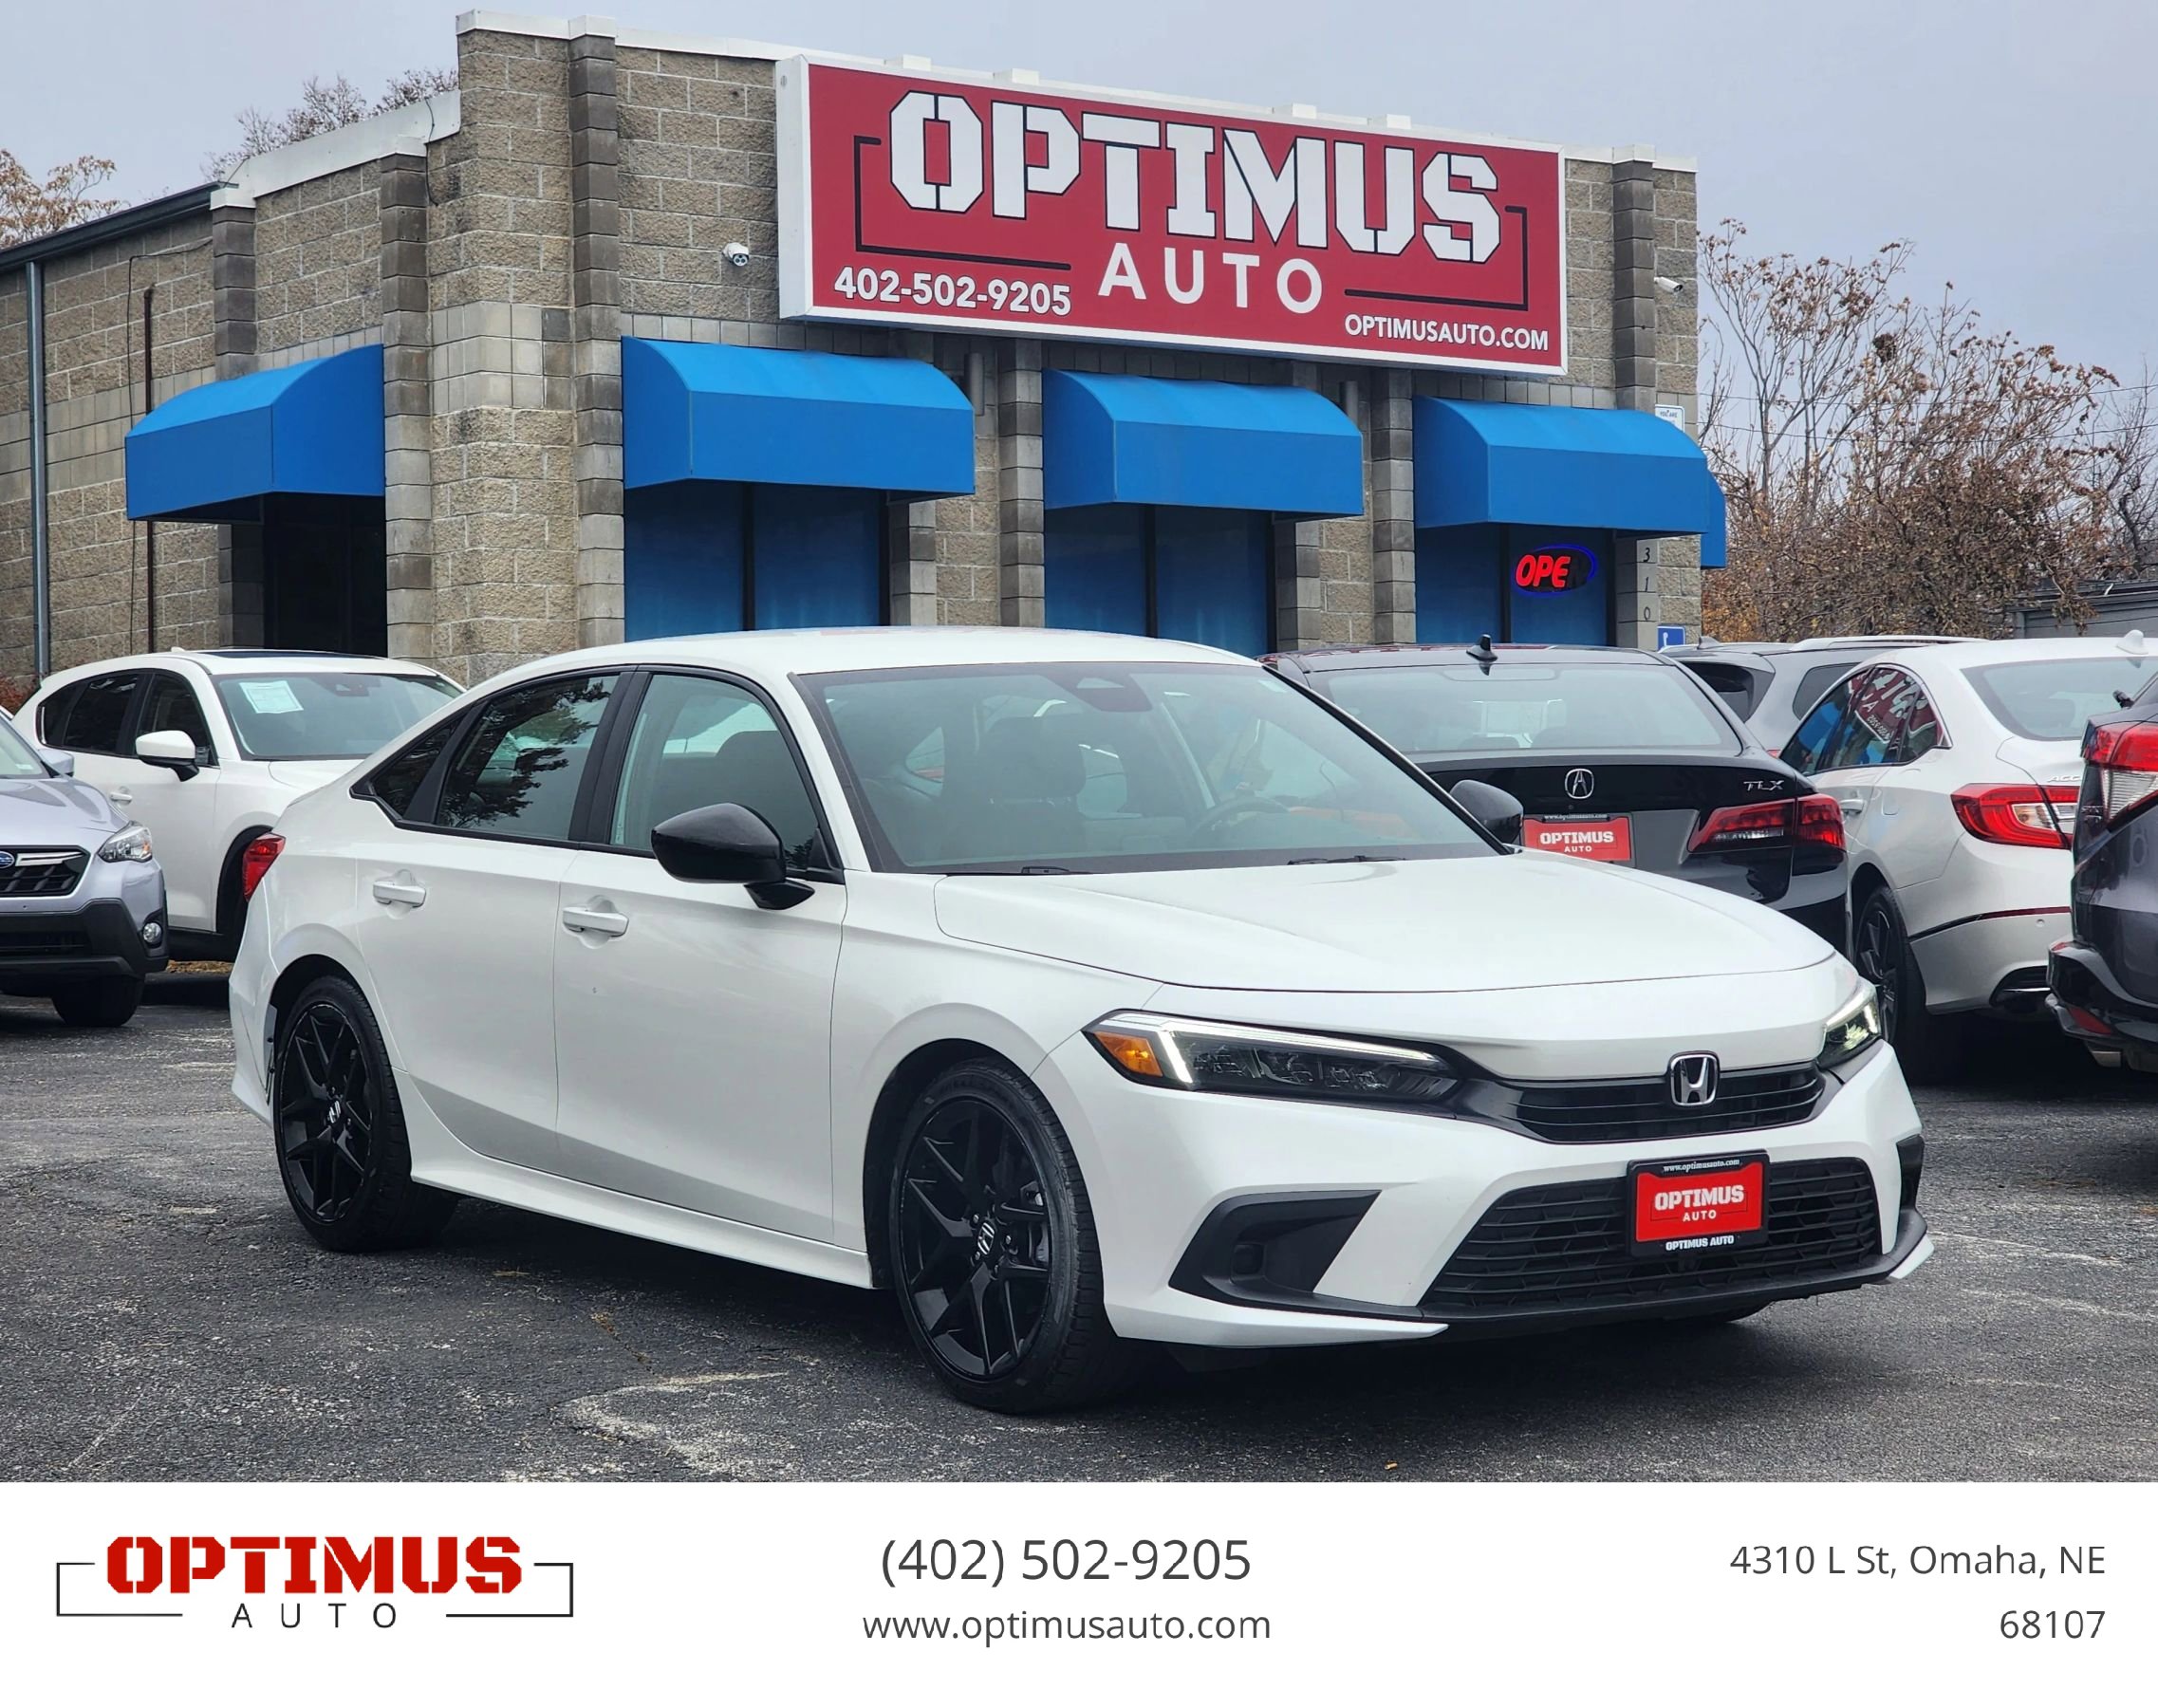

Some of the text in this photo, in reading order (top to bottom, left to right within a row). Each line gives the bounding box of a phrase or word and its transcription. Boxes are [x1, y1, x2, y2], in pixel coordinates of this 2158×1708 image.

[890, 91, 1501, 264] OPTIMUS
[1098, 242, 1323, 314] AUTO
[834, 267, 1071, 316] 402-502-9205
[1344, 313, 1549, 351] OPTIMUSAUTO.COM
[1516, 554, 1572, 588] OPE
[1743, 780, 1784, 791] TLX
[1539, 831, 1614, 845] OPTIMUS
[1564, 845, 1592, 853] AUTO
[1663, 1159, 1740, 1173] www.optimusauto.com
[1654, 1184, 1745, 1211] OPTIMUS
[1682, 1209, 1717, 1222] AUTO
[1665, 1235, 1735, 1251] OPTIMUS AUTO
